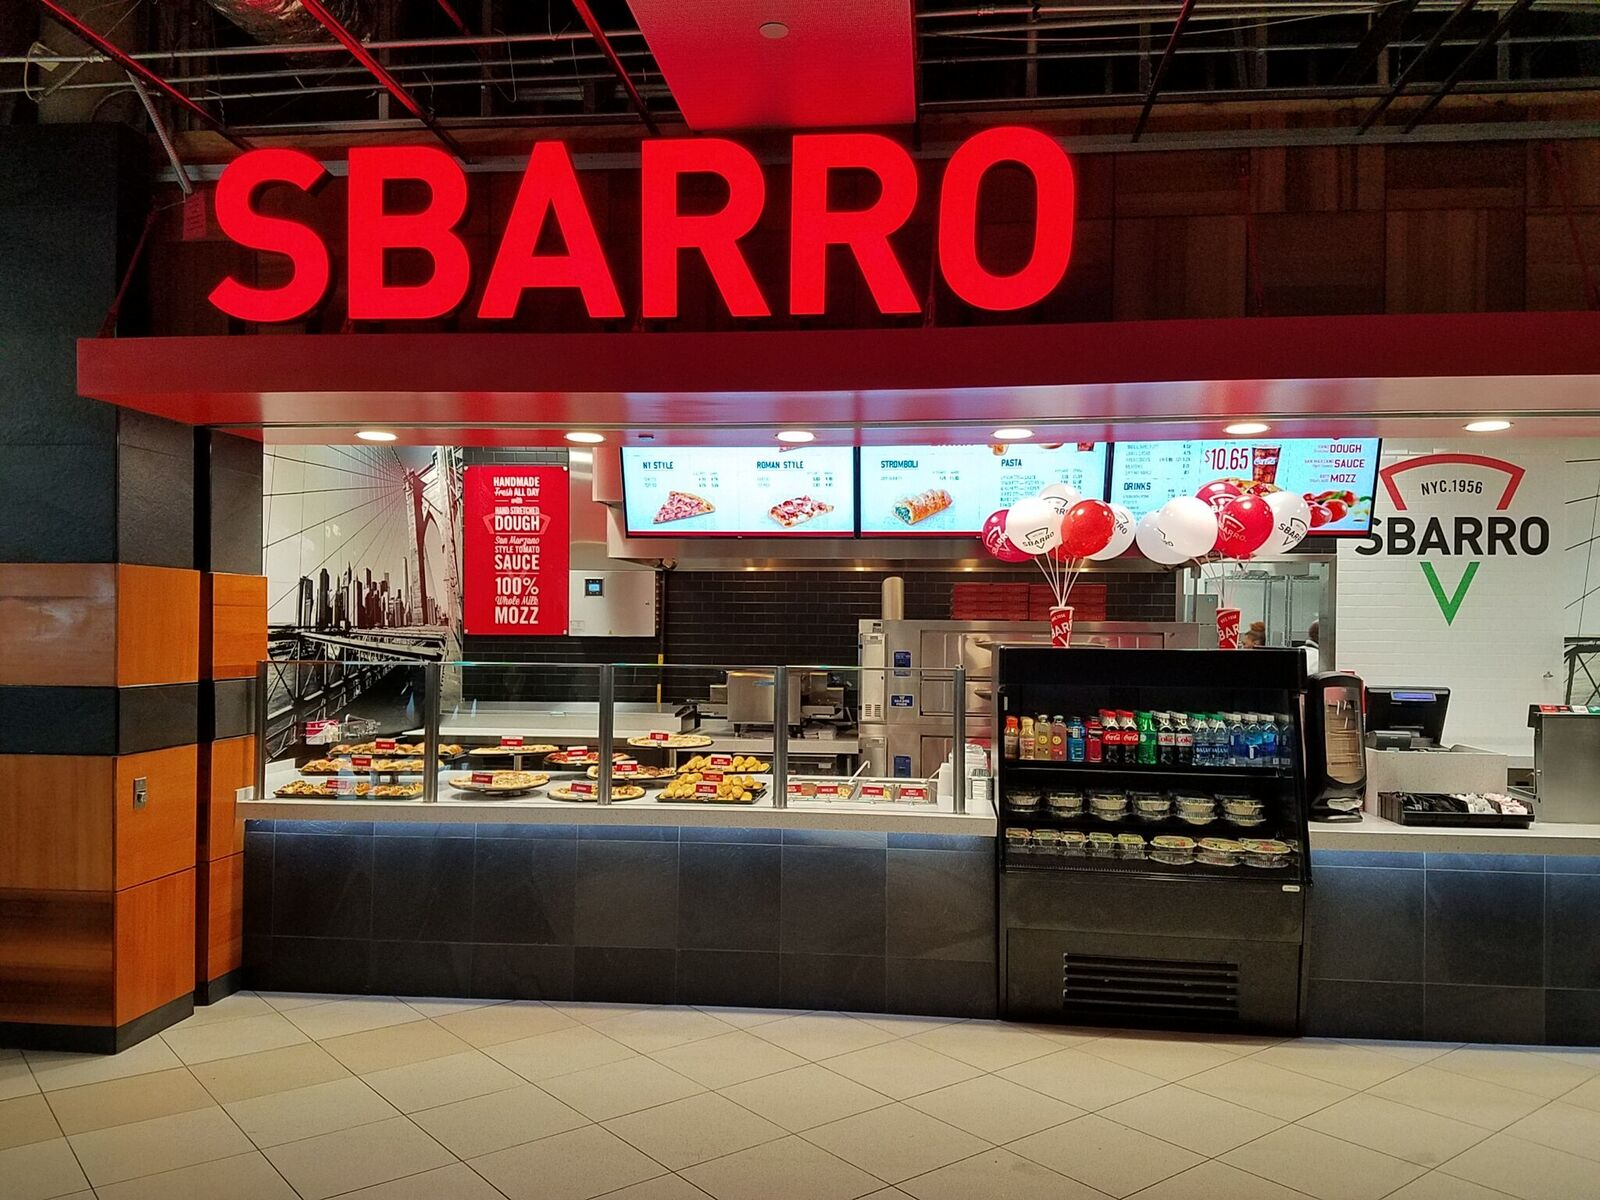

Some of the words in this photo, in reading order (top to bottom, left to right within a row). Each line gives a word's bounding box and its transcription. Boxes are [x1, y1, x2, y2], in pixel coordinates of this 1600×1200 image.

[208, 127, 1075, 323] SBARRO
[1329, 444, 1362, 453] DOUGH
[1001, 459, 1022, 467] PASTA
[1204, 448, 1249, 470] $10.65
[1334, 459, 1366, 468] SAUCE
[653, 461, 674, 470] STYLE
[757, 461, 780, 469] ROMAN
[783, 461, 804, 469] STYLE
[880, 460, 919, 469] STROMBOLI
[493, 476, 540, 487] HANDMADE
[1330, 474, 1356, 483] MOZZ
[1123, 482, 1151, 491] DRINKS
[513, 488, 526, 497] ALL
[526, 488, 540, 497] DAY
[494, 515, 540, 531] DOUGH
[1022, 531, 1055, 547] SBARRO
[1355, 517, 1550, 555] SBARRO
[494, 535, 508, 545] San
[508, 535, 540, 548] Marzano
[494, 546, 514, 554] STYLE
[515, 546, 540, 554] TOMATO
[494, 554, 540, 570] SAUCE
[495, 577, 539, 595] 100%
[494, 606, 539, 625] MOZZ
